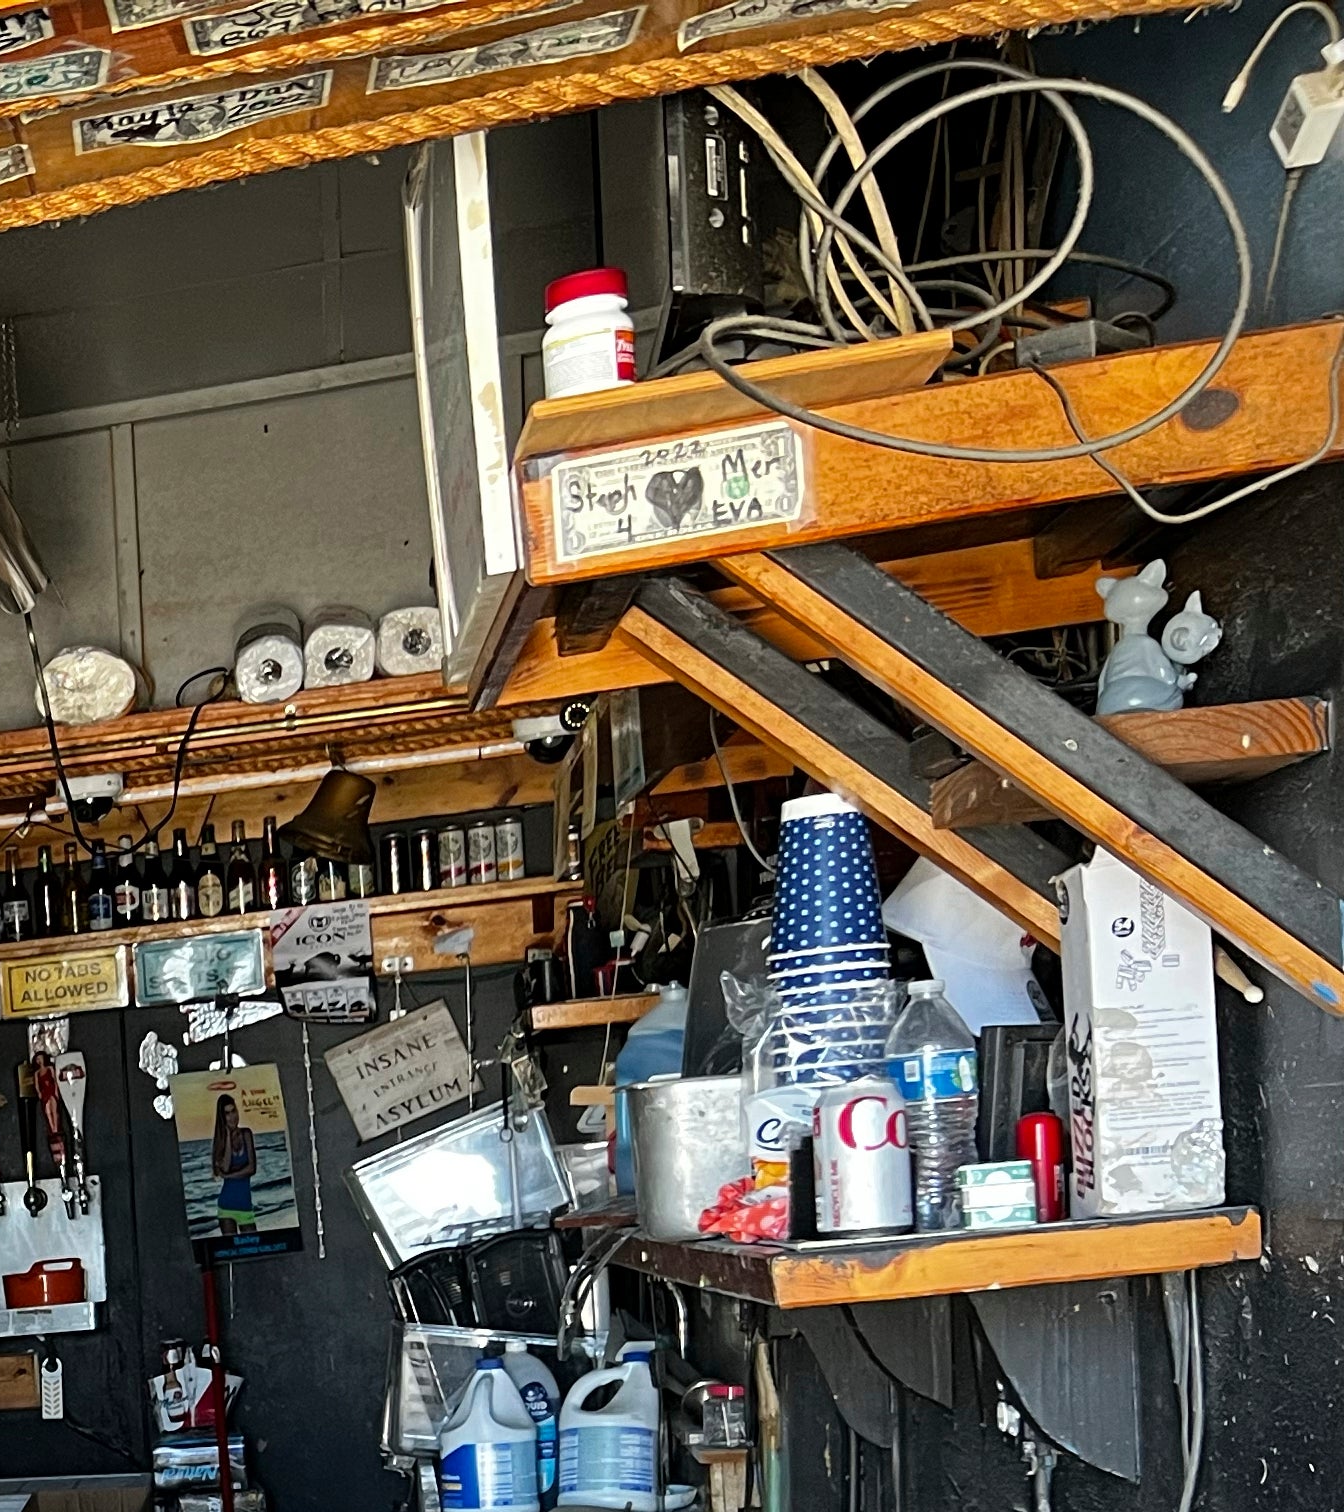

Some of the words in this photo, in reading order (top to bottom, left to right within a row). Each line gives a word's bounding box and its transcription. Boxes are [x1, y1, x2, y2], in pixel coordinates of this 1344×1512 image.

[565, 473, 637, 515] Steph
[721, 449, 780, 483] Mer
[712, 497, 763, 523] EVA
[295, 932, 346, 946] ICON
[24, 967, 54, 984] NO
[56, 961, 102, 981] TABS
[20, 980, 109, 1003] ALLOWED
[355, 1033, 438, 1080] INSANE
[375, 1077, 462, 1130] ASYLUM
[838, 1095, 909, 1151] Co
